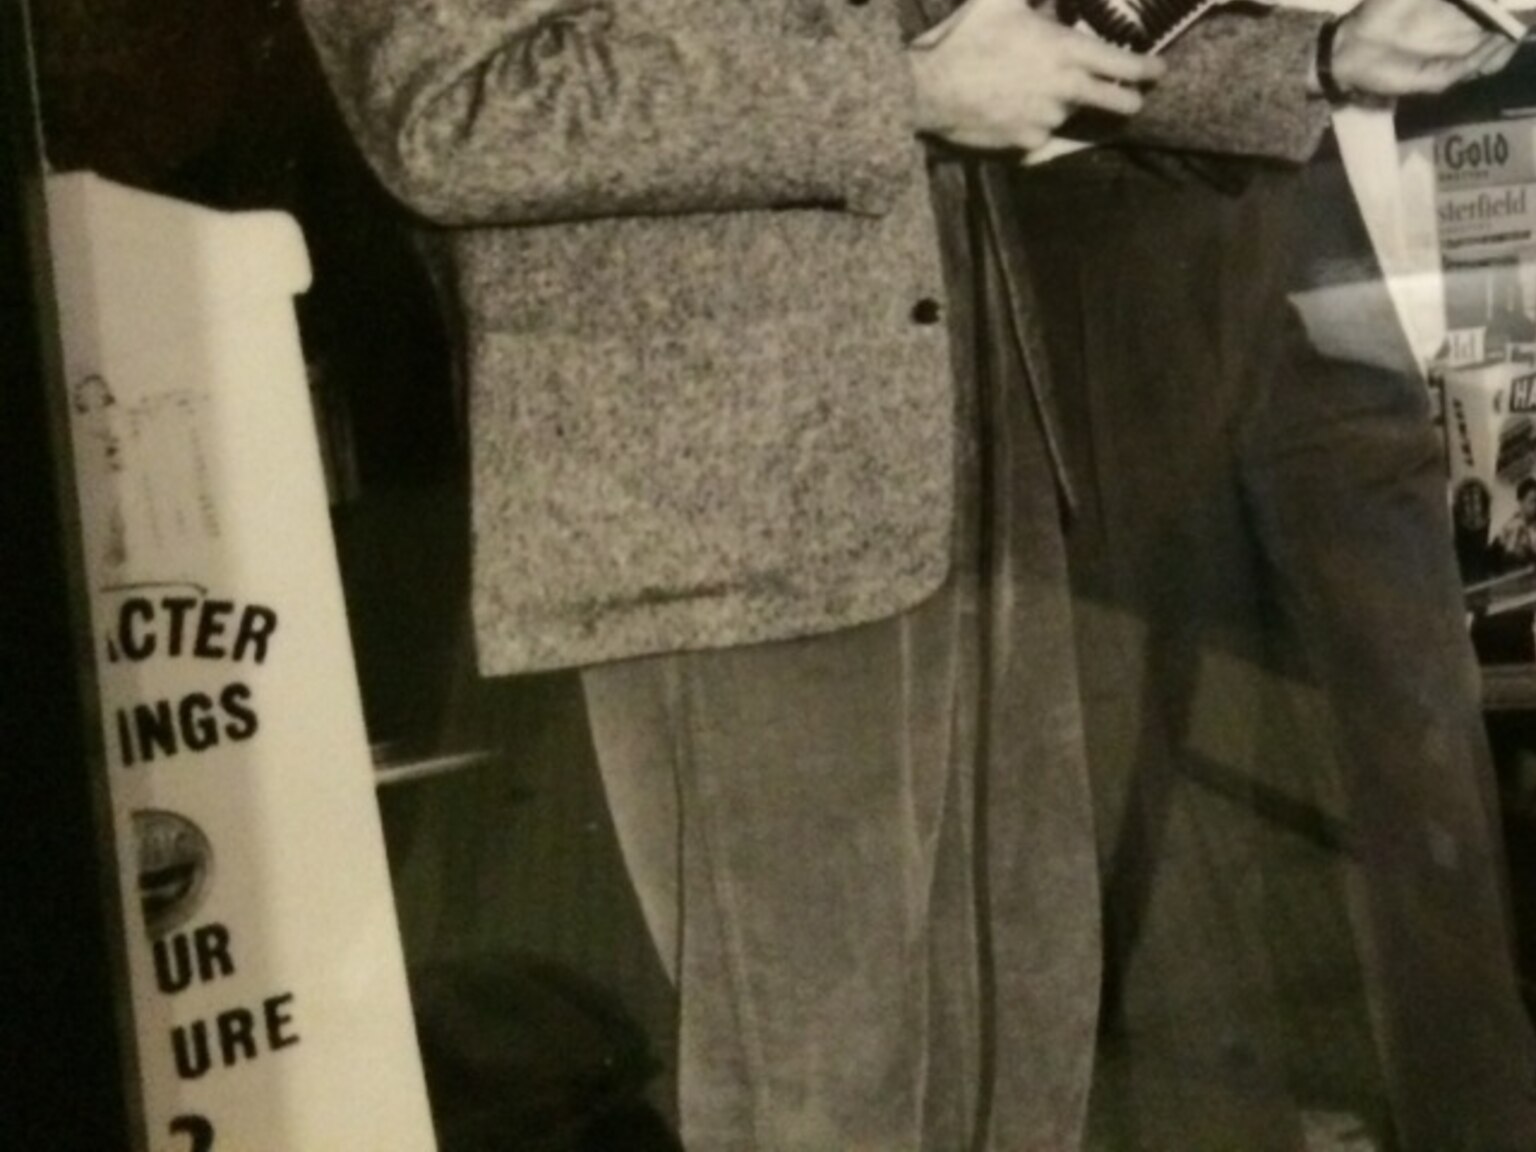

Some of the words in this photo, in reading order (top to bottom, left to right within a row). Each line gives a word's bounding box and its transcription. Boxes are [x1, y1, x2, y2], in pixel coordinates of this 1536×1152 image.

[1444, 132, 1509, 170] Gold
[108, 598, 278, 665] CTER
[117, 682, 259, 767] INGS
[151, 923, 236, 995] UR
[171, 992, 301, 1080] URE
